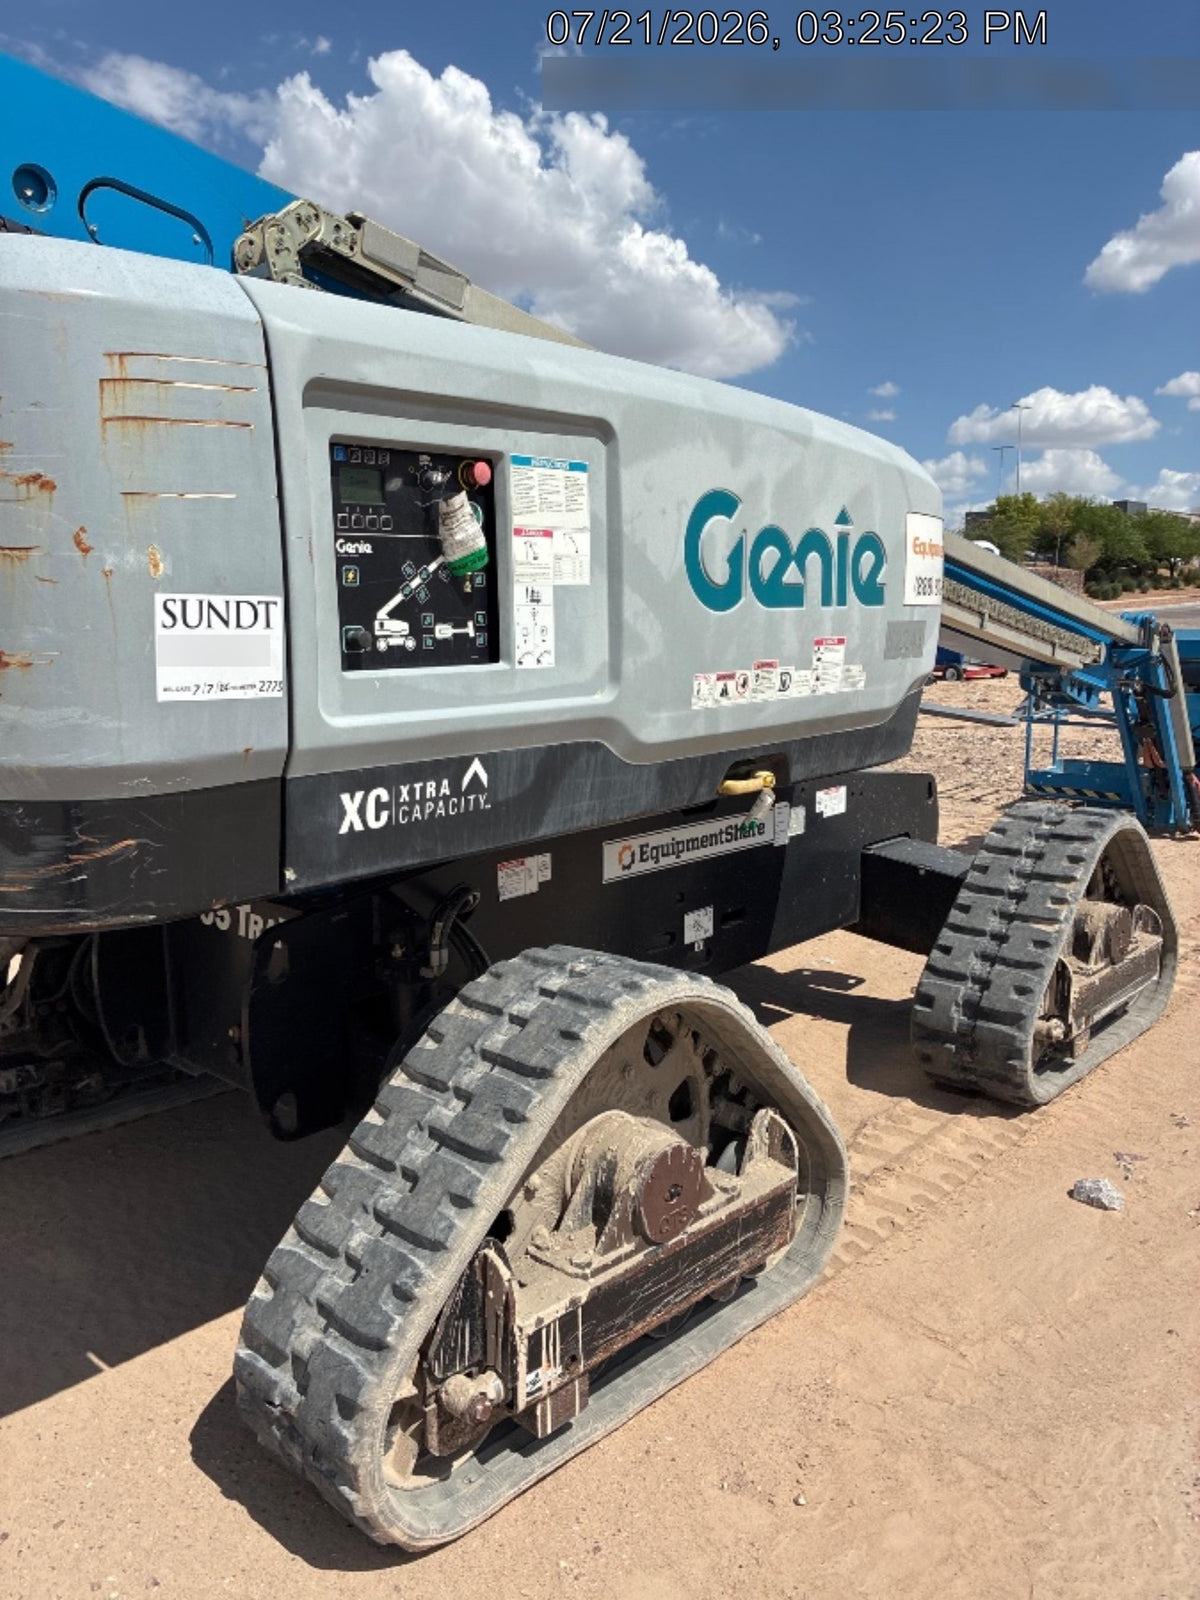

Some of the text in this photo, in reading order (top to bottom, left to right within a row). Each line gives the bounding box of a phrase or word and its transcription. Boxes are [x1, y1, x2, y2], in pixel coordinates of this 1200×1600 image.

[336, 538, 373, 554] Genie
[684, 487, 887, 613] Genie
[161, 598, 278, 629] SUNDT
[338, 778, 450, 834] XC XTRA
[399, 793, 488, 824] CAPACITY
